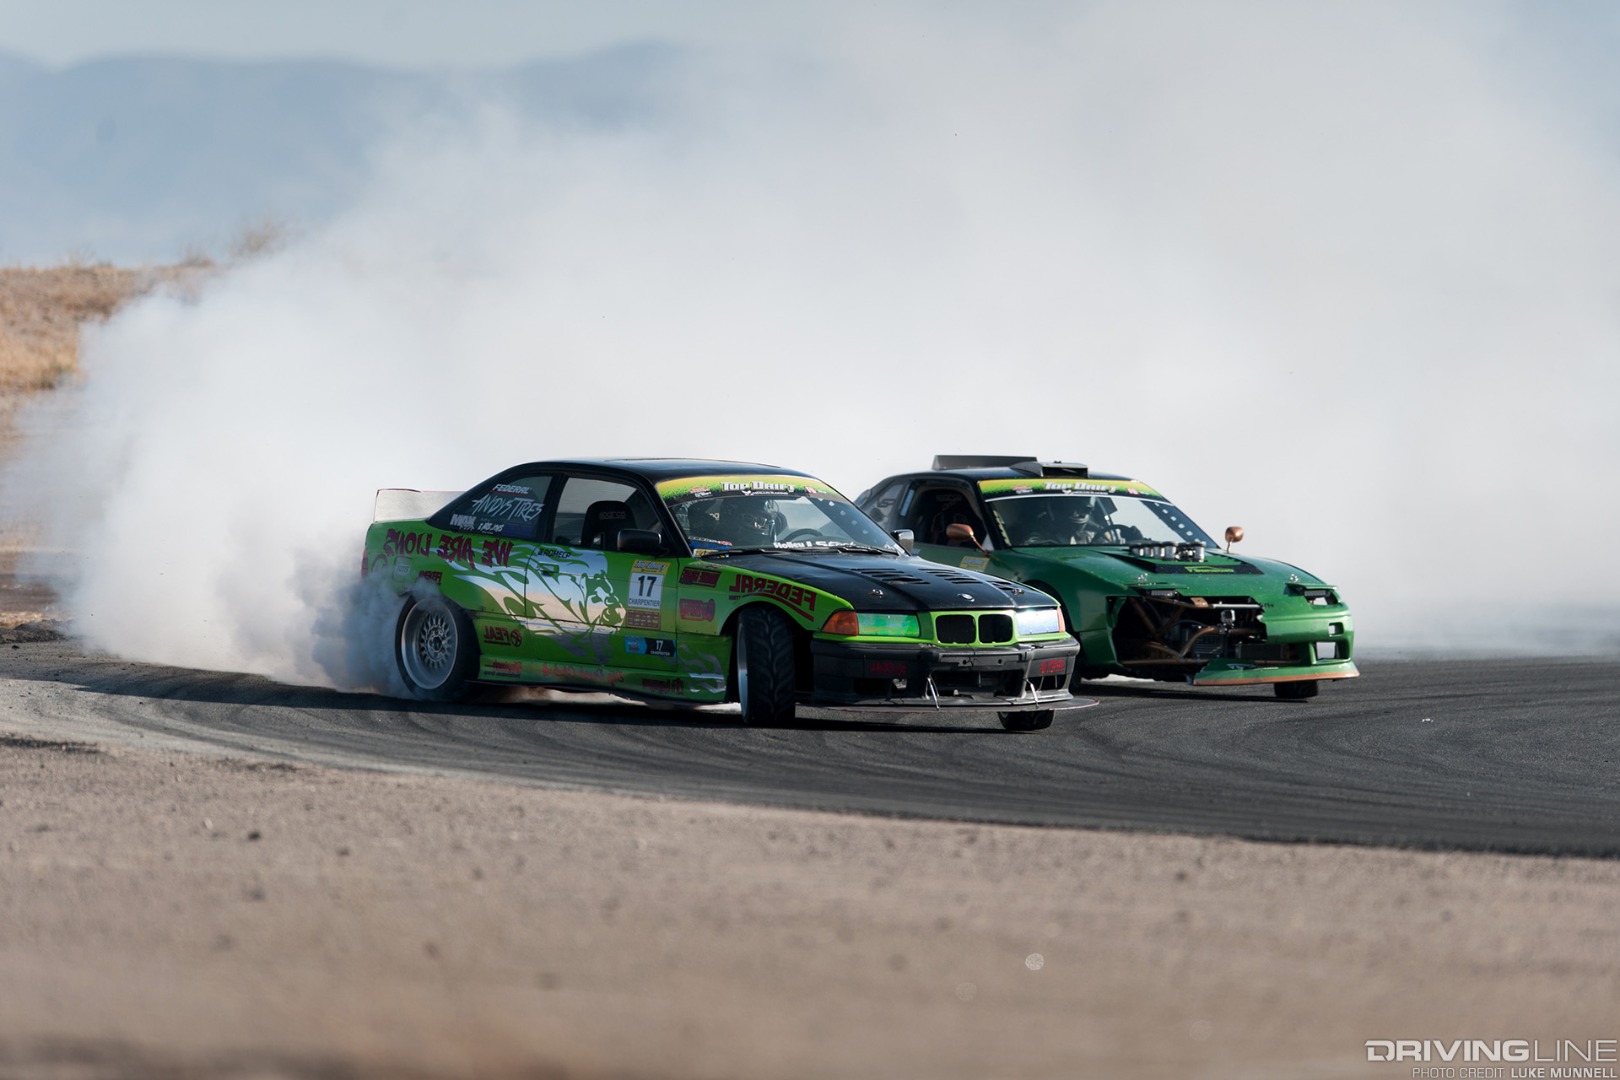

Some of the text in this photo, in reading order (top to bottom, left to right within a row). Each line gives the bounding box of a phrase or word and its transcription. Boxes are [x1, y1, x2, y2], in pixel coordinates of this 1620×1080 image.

[492, 483, 530, 494] FEDERAL
[507, 497, 545, 521] TIRES
[638, 575, 657, 597] 17
[629, 597, 660, 608] CHARPENTIER
[656, 640, 664, 651] 17
